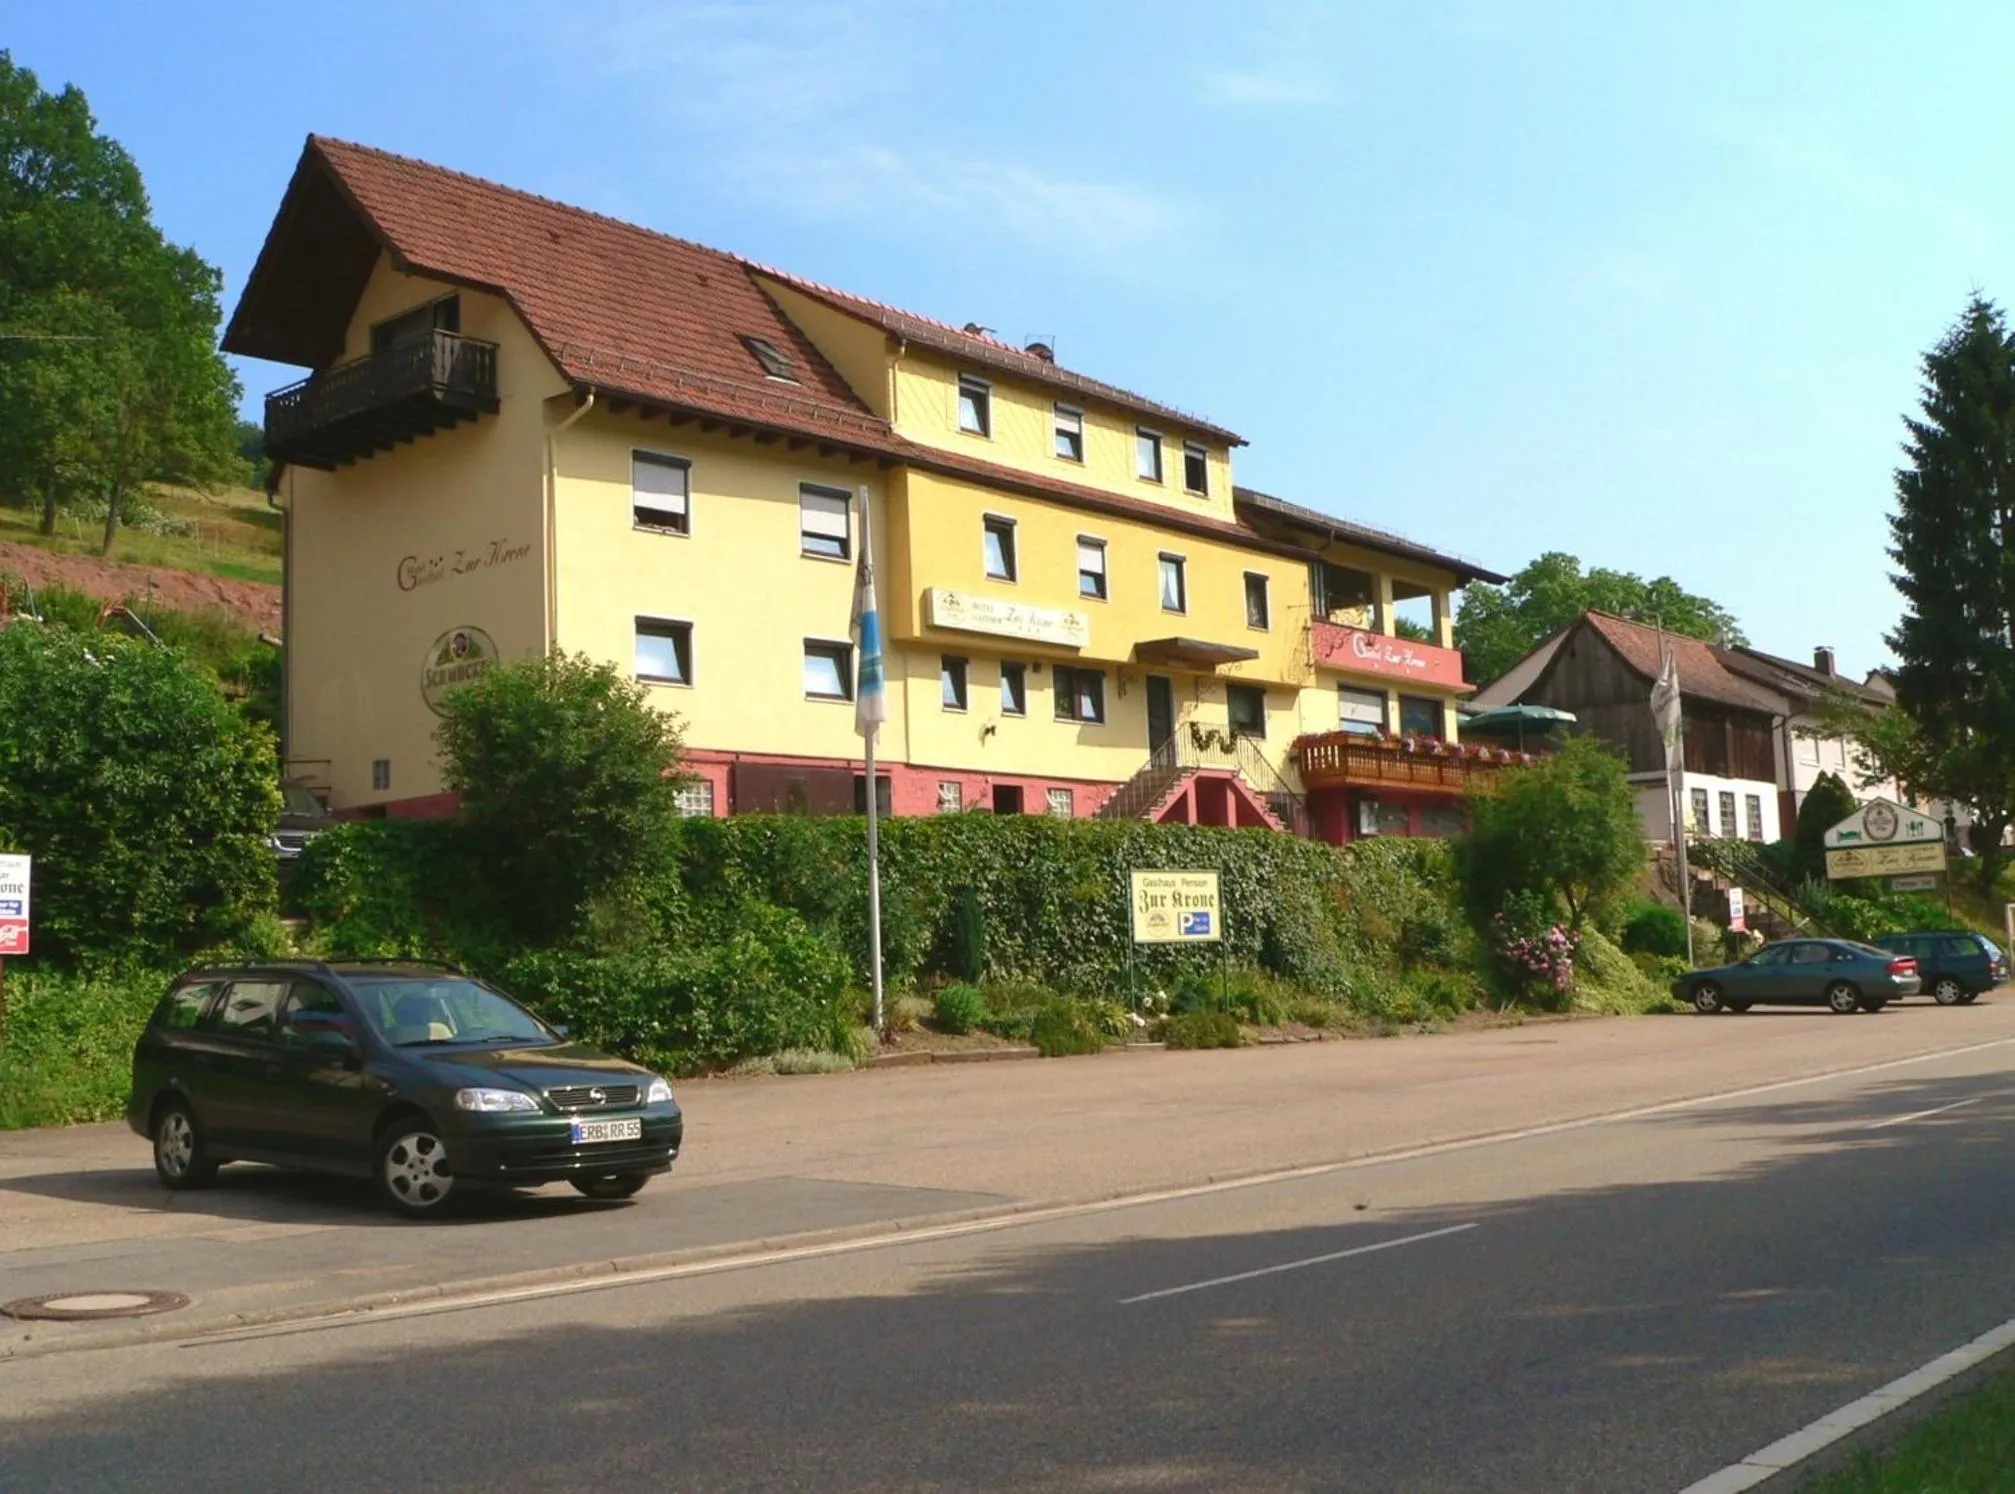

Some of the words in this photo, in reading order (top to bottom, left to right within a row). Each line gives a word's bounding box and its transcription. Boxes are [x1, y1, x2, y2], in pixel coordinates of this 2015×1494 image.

[0, 883, 25, 894] one
[1139, 889, 1165, 913] Zur
[1172, 890, 1214, 908] Krone
